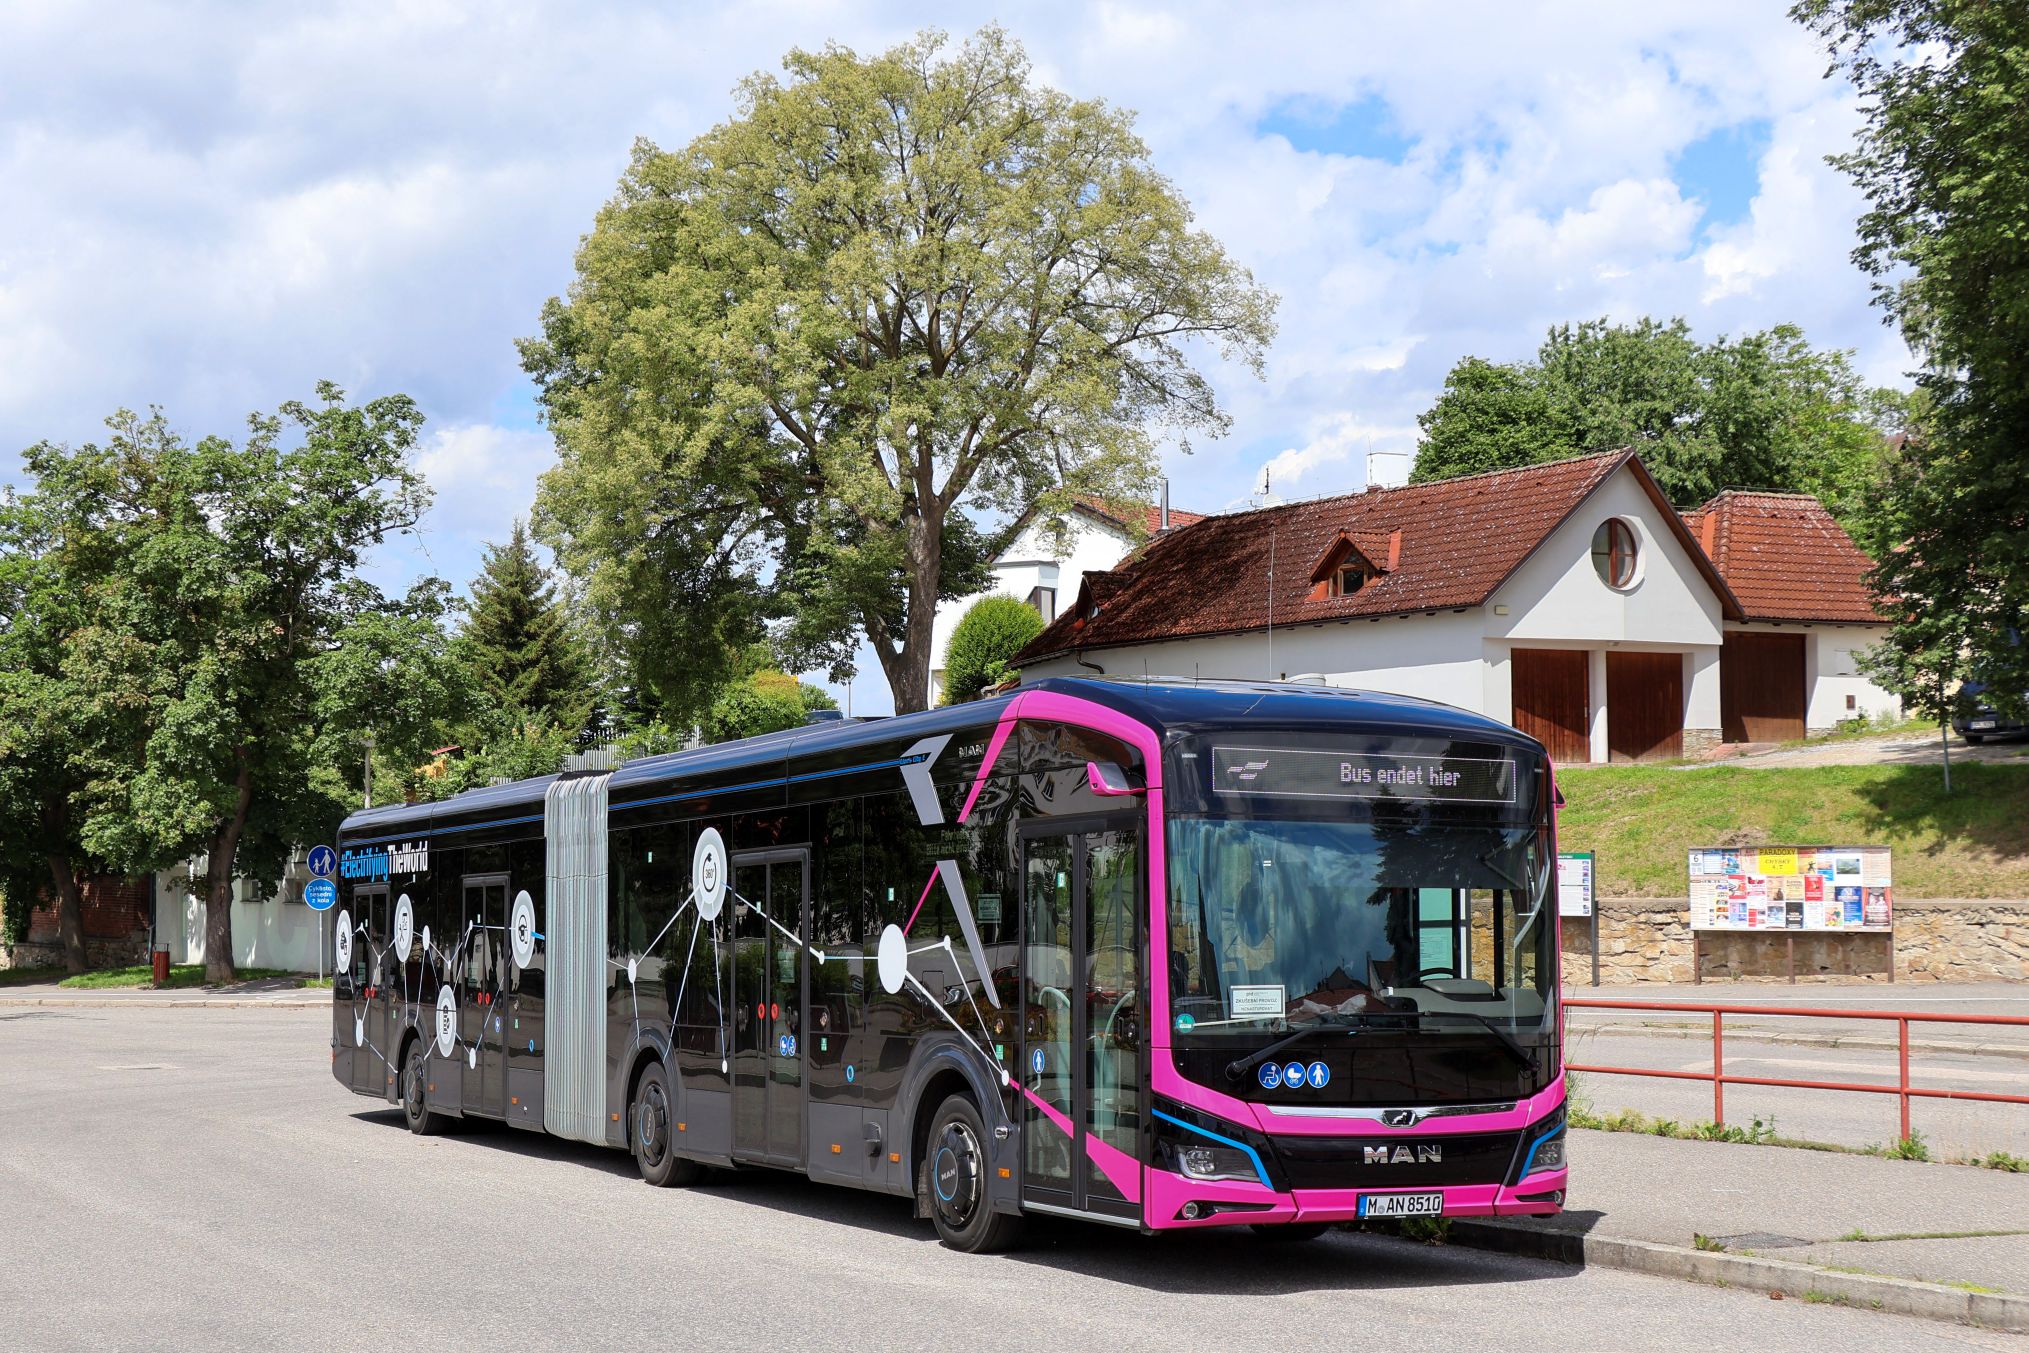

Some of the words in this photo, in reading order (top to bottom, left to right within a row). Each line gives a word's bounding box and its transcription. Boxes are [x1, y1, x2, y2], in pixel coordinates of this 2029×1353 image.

[958, 743, 984, 758] MAN
[1340, 762, 1372, 782] Bus
[1377, 765, 1423, 785] endet
[1429, 766, 1461, 786] hier
[340, 840, 428, 882] #ElectrifyingTheWorld
[1759, 848, 1796, 856] PARADOXY
[1363, 1145, 1442, 1164] MAN
[941, 1168, 956, 1181] MAN
[1367, 1198, 1378, 1214] M
[1386, 1197, 1405, 1213] AN
[1407, 1196, 1441, 1213] 8510
